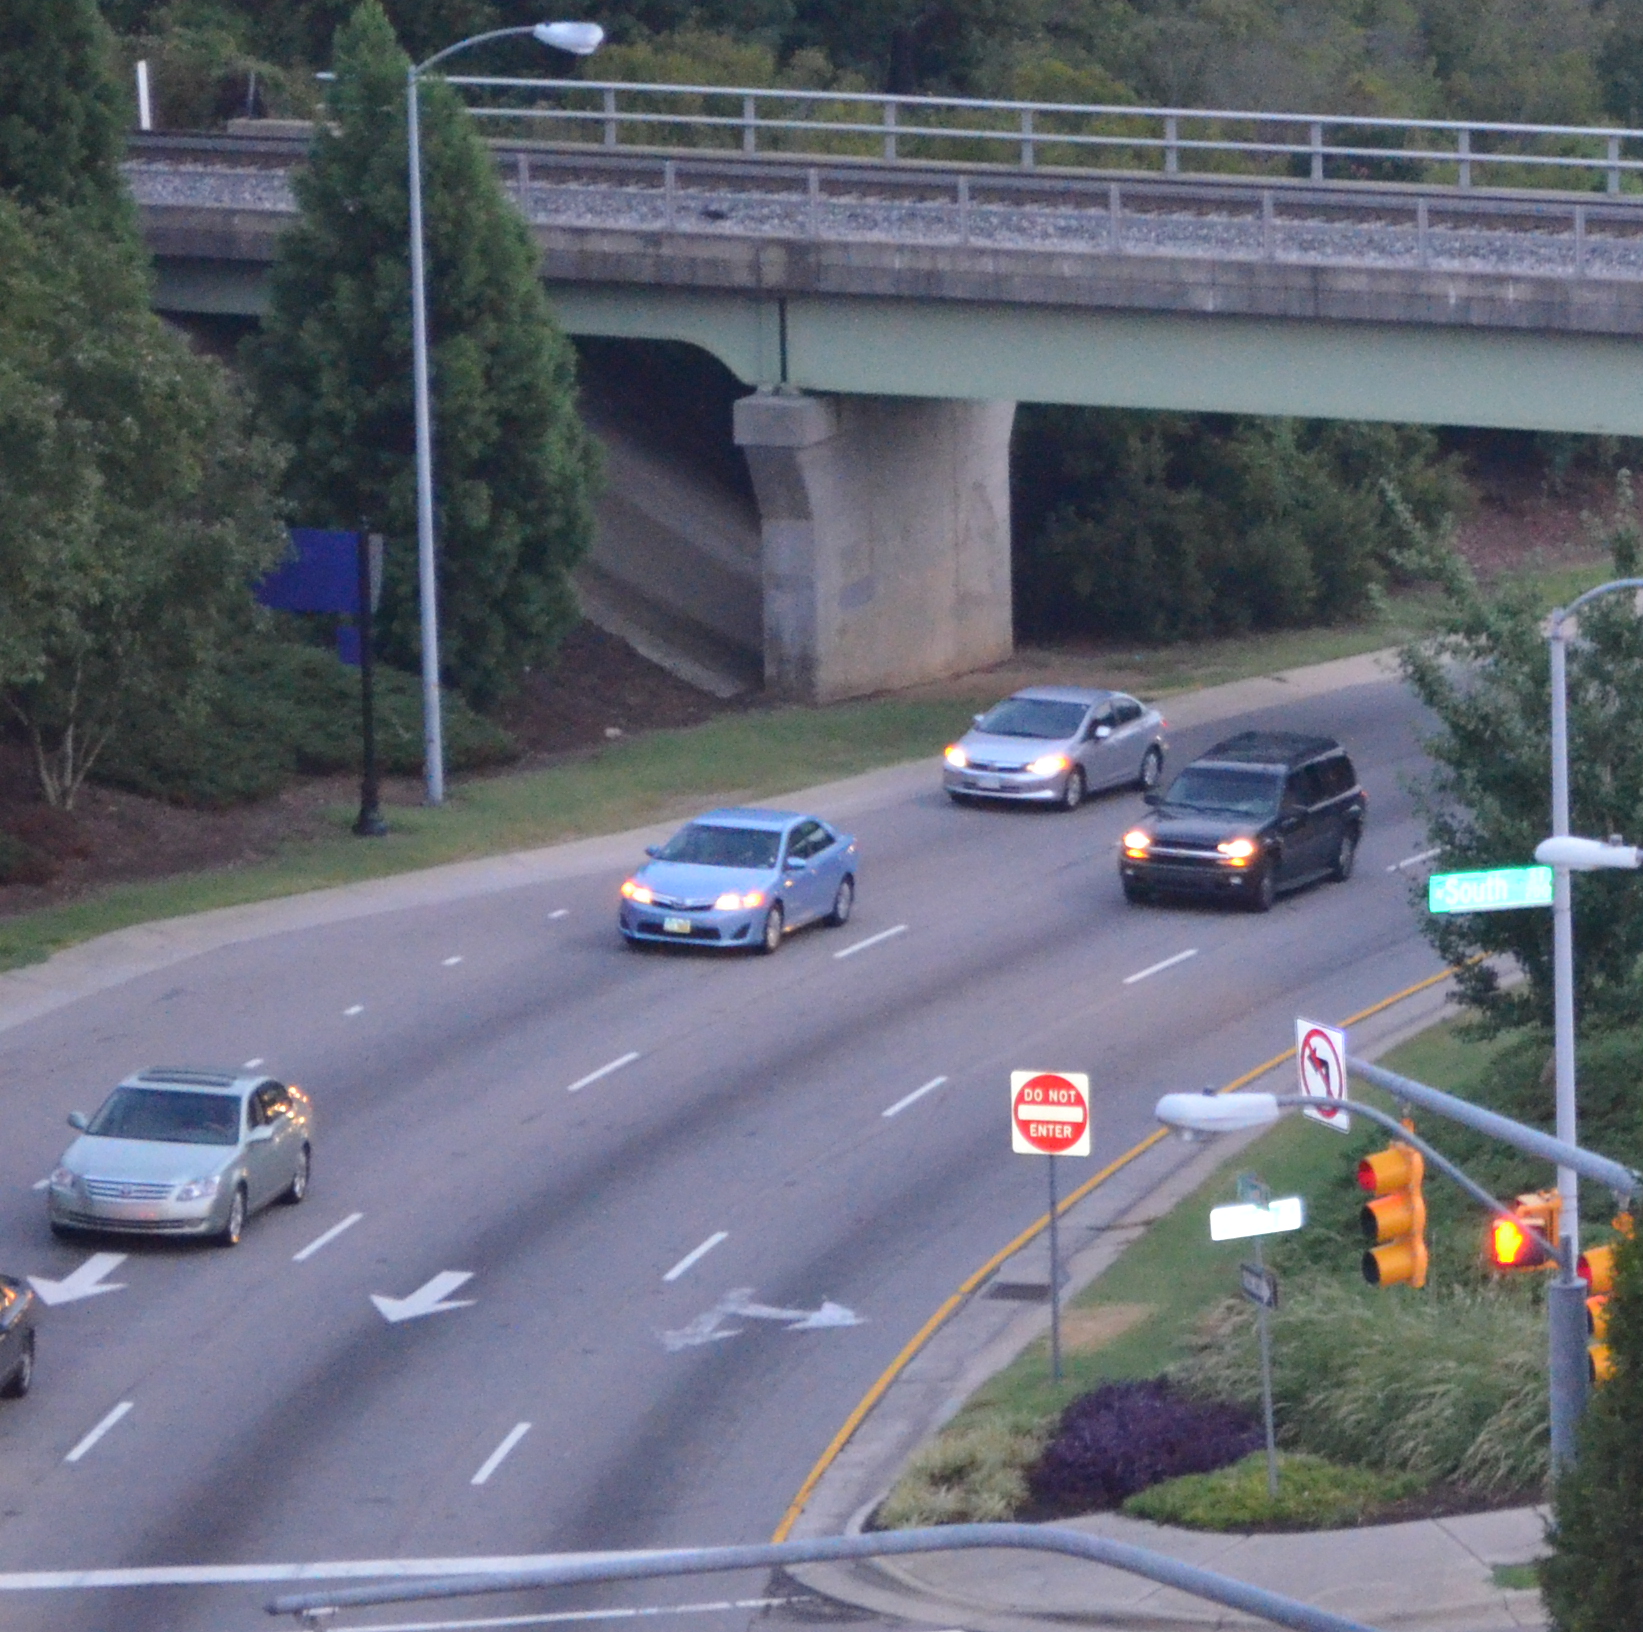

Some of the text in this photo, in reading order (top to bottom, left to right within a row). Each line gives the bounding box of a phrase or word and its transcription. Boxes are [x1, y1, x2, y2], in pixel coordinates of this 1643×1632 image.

[1445, 875, 1509, 905] South
[1024, 1088, 1077, 1103] DO NOT
[1030, 1124, 1073, 1138] ENTER
